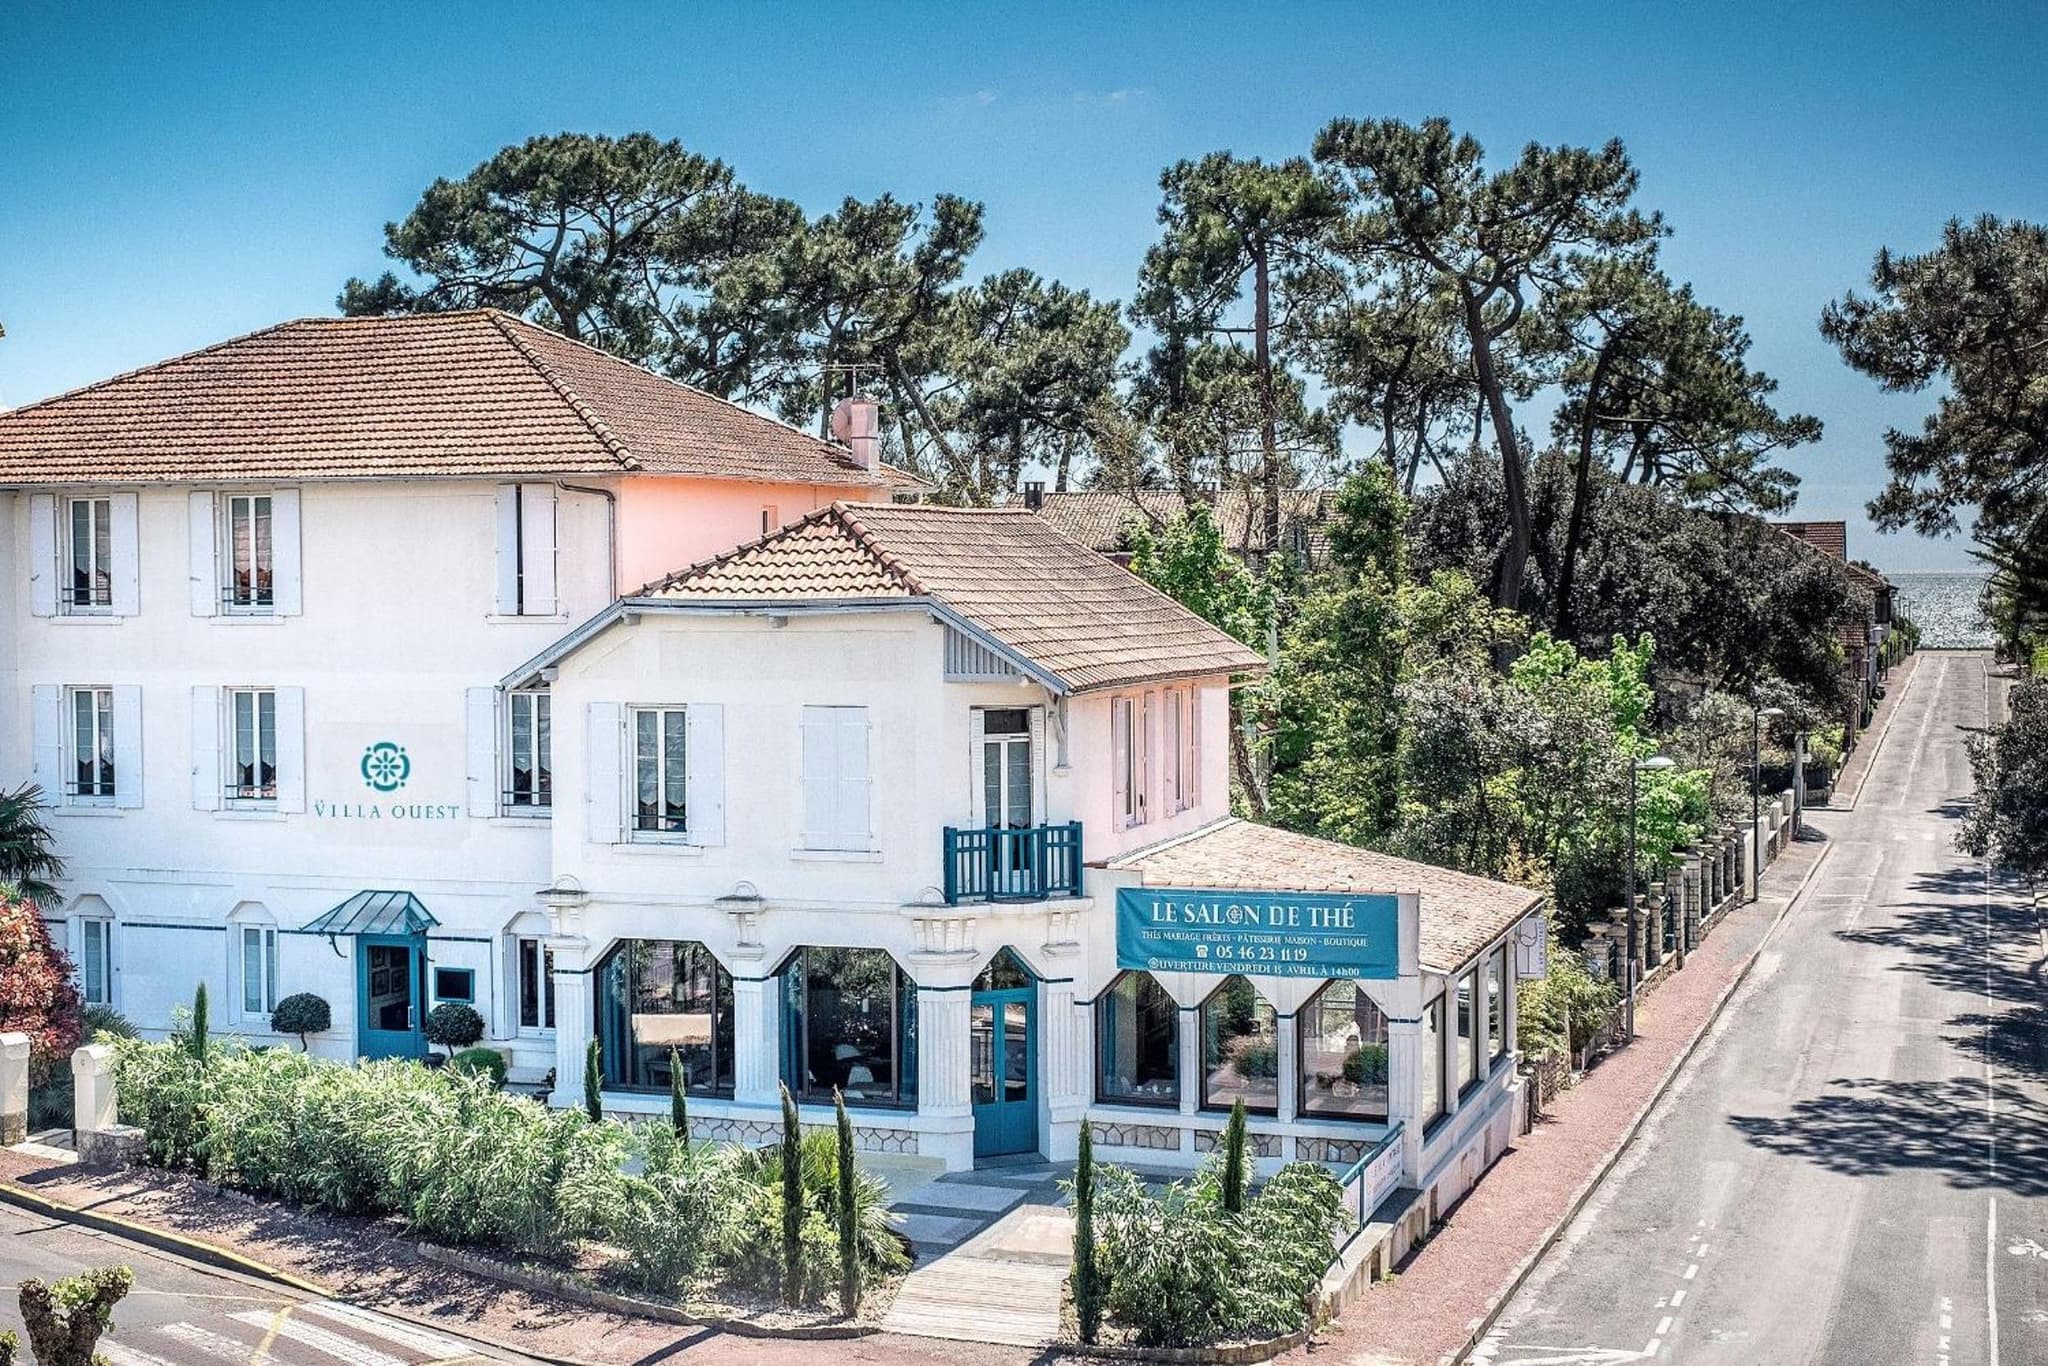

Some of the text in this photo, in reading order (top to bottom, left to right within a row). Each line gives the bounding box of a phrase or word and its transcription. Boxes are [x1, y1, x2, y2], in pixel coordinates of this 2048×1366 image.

[314, 800, 460, 819] VILLA OUEST
[1152, 902, 1355, 928] LE SALON DE THÉ
[1163, 932, 1200, 942] MARIAGE
[1202, 932, 1231, 942] FRÈRES
[1238, 933, 1281, 945] PÂTISSERIE
[1285, 936, 1317, 945] MAISON
[1324, 937, 1368, 948] BOUTIQUE
[1216, 945, 1307, 961] 05 46 23 11 19
[1148, 957, 1216, 971] OUVERTURE
[1216, 962, 1271, 973] VENDREDI
[1286, 966, 1318, 975] AVRIL
[1319, 965, 1328, 976] À
[1331, 966, 1360, 977] 14h00
